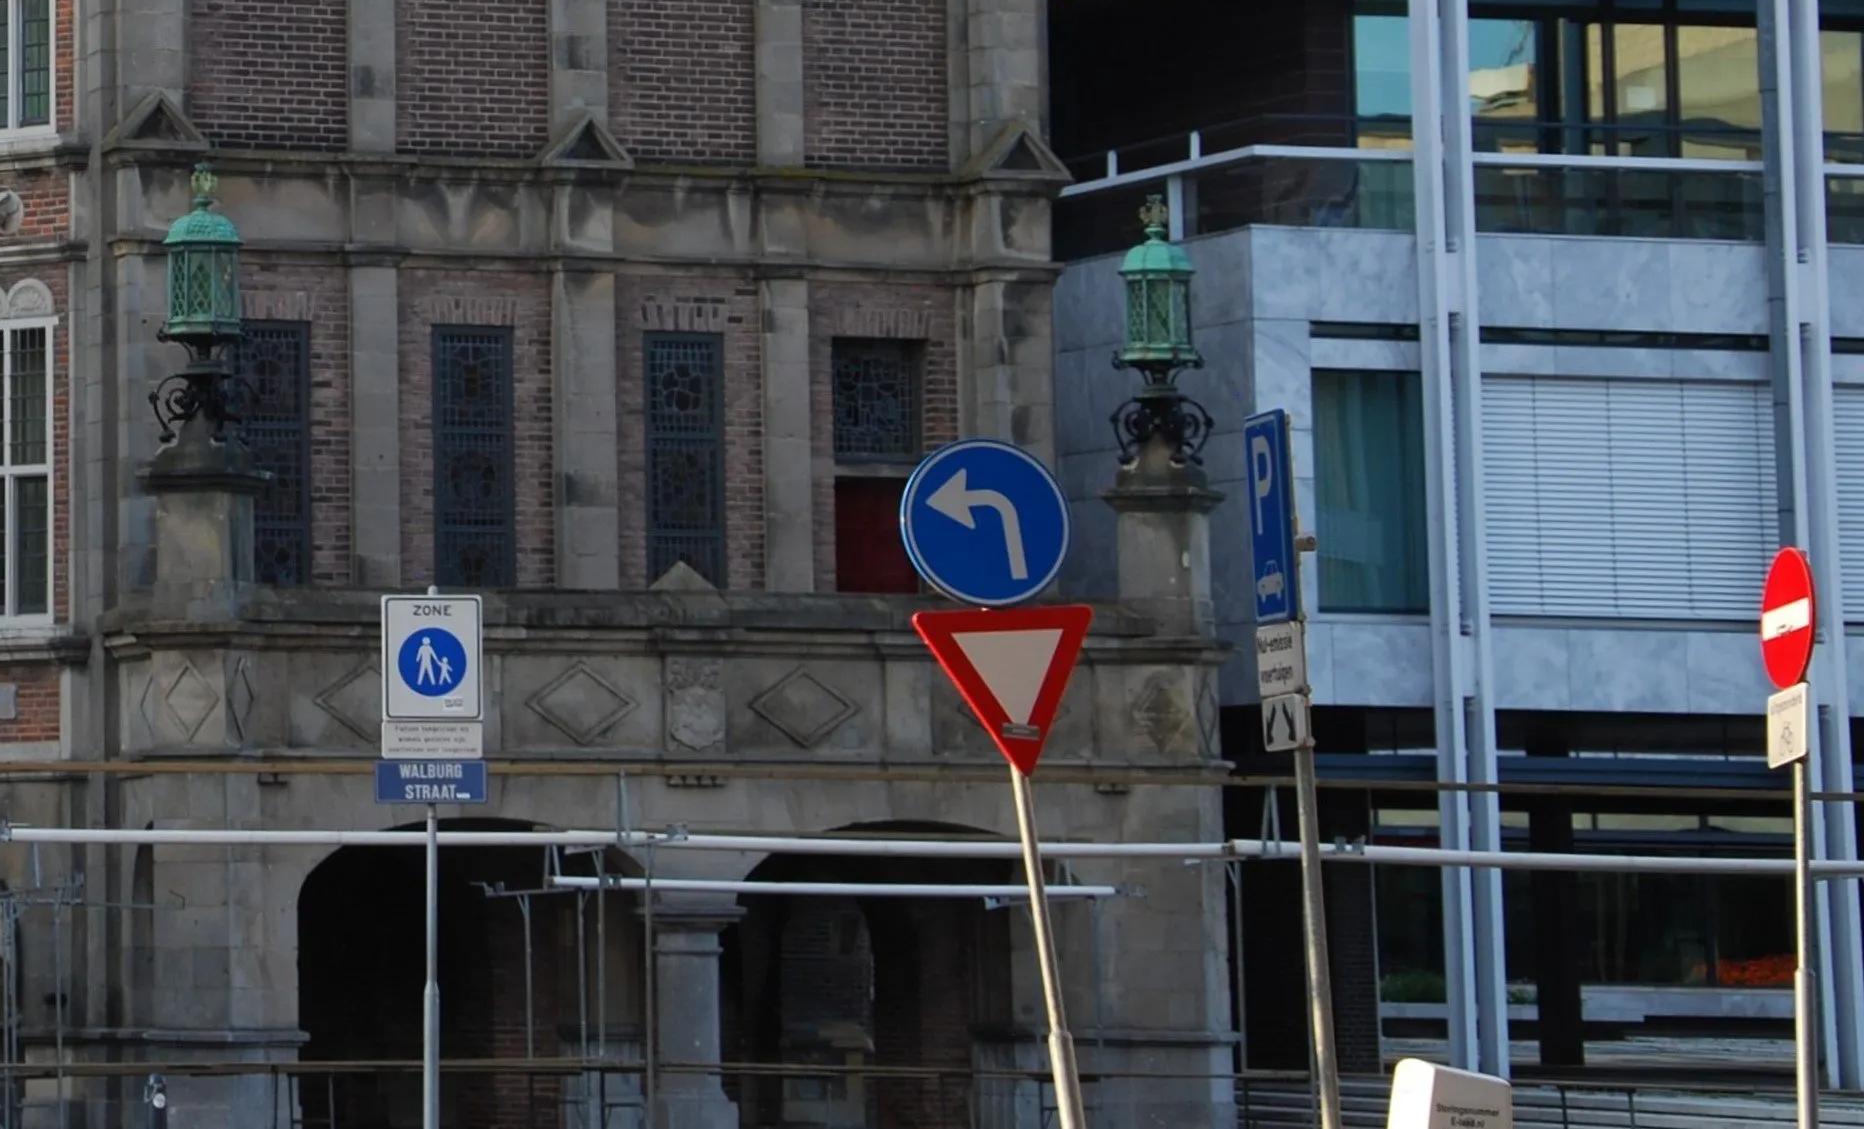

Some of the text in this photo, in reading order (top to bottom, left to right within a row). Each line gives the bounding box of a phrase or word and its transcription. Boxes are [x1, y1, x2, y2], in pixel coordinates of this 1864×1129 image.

[1250, 435, 1273, 536] P
[412, 604, 452, 616] ZONE
[399, 764, 463, 779] WALBURG
[404, 784, 457, 800] STRAAT
